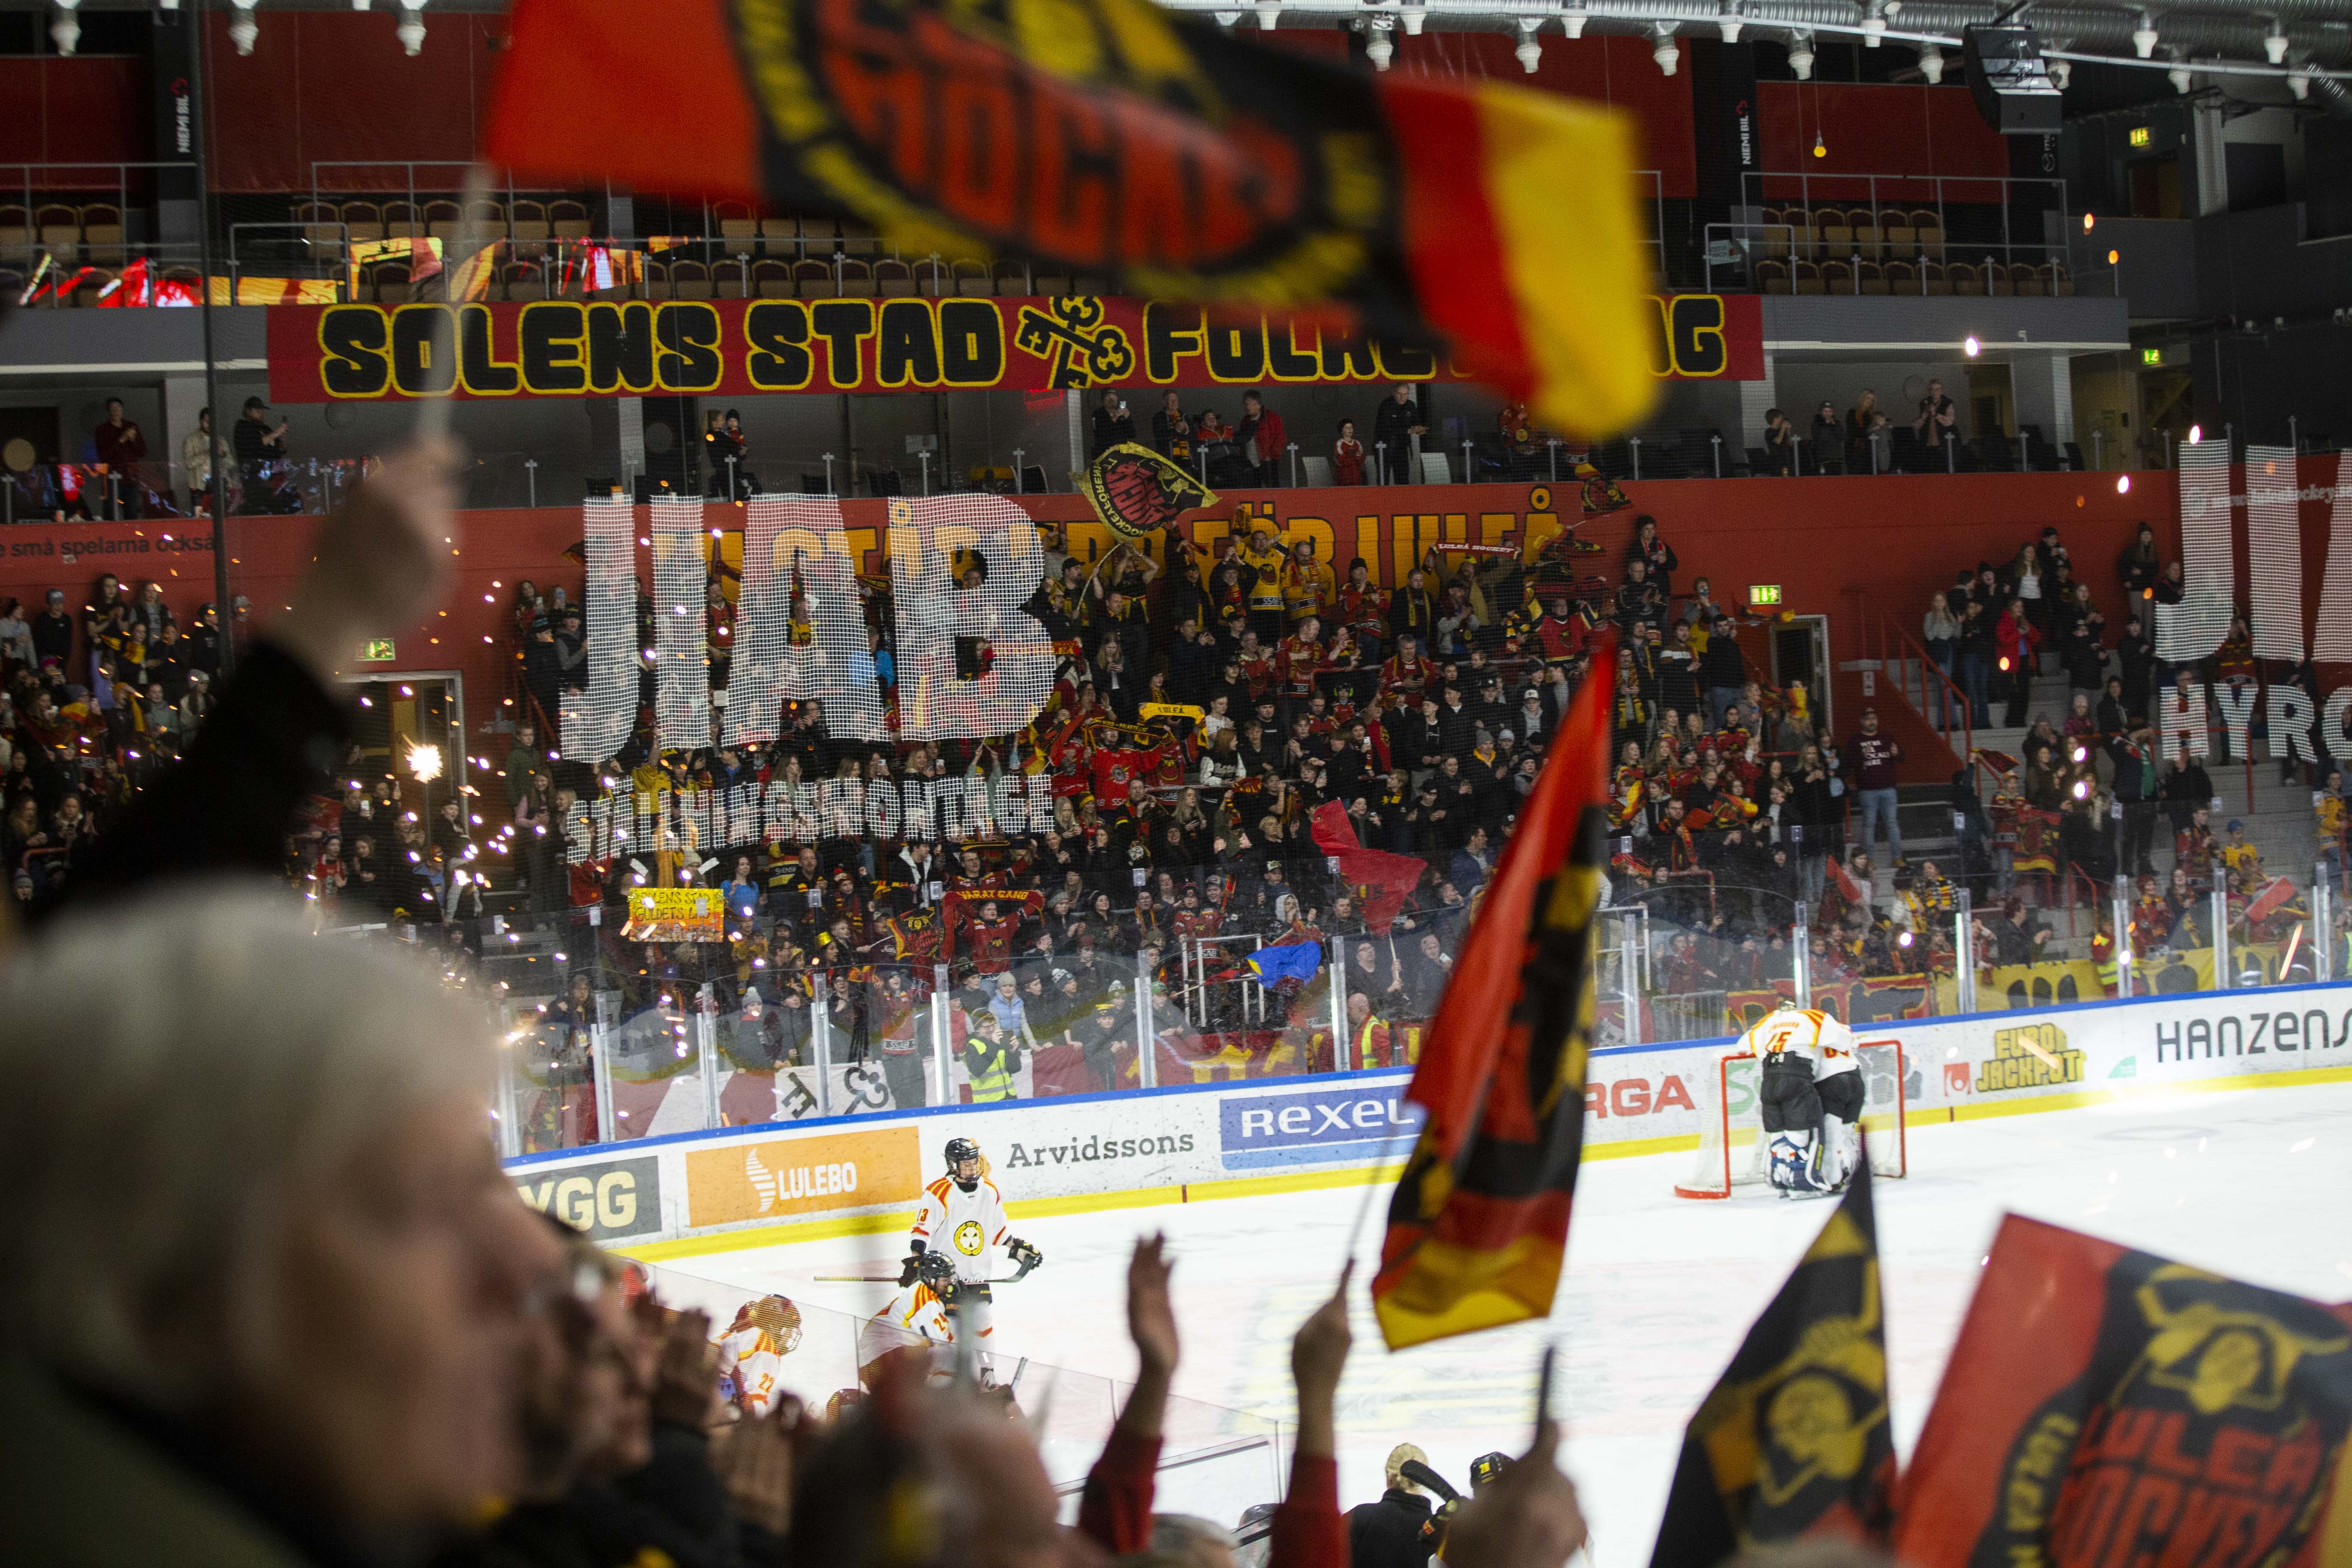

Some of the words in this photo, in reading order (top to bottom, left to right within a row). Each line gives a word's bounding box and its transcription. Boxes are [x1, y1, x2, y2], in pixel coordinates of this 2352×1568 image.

[1740, 115, 1749, 132] BIL
[1740, 133, 1752, 165] NIEMI
[318, 301, 723, 397] SOLENS
[744, 297, 1006, 390] STAD
[10, 537, 55, 557] små
[61, 536, 150, 555] spelarna
[2154, 439, 2352, 663] JI
[560, 493, 1057, 763] JIAB
[1006, 1133, 1194, 1169] Arvidssons
[777, 1161, 857, 1200] LULEBO
[758, 1372, 775, 1393] 22
